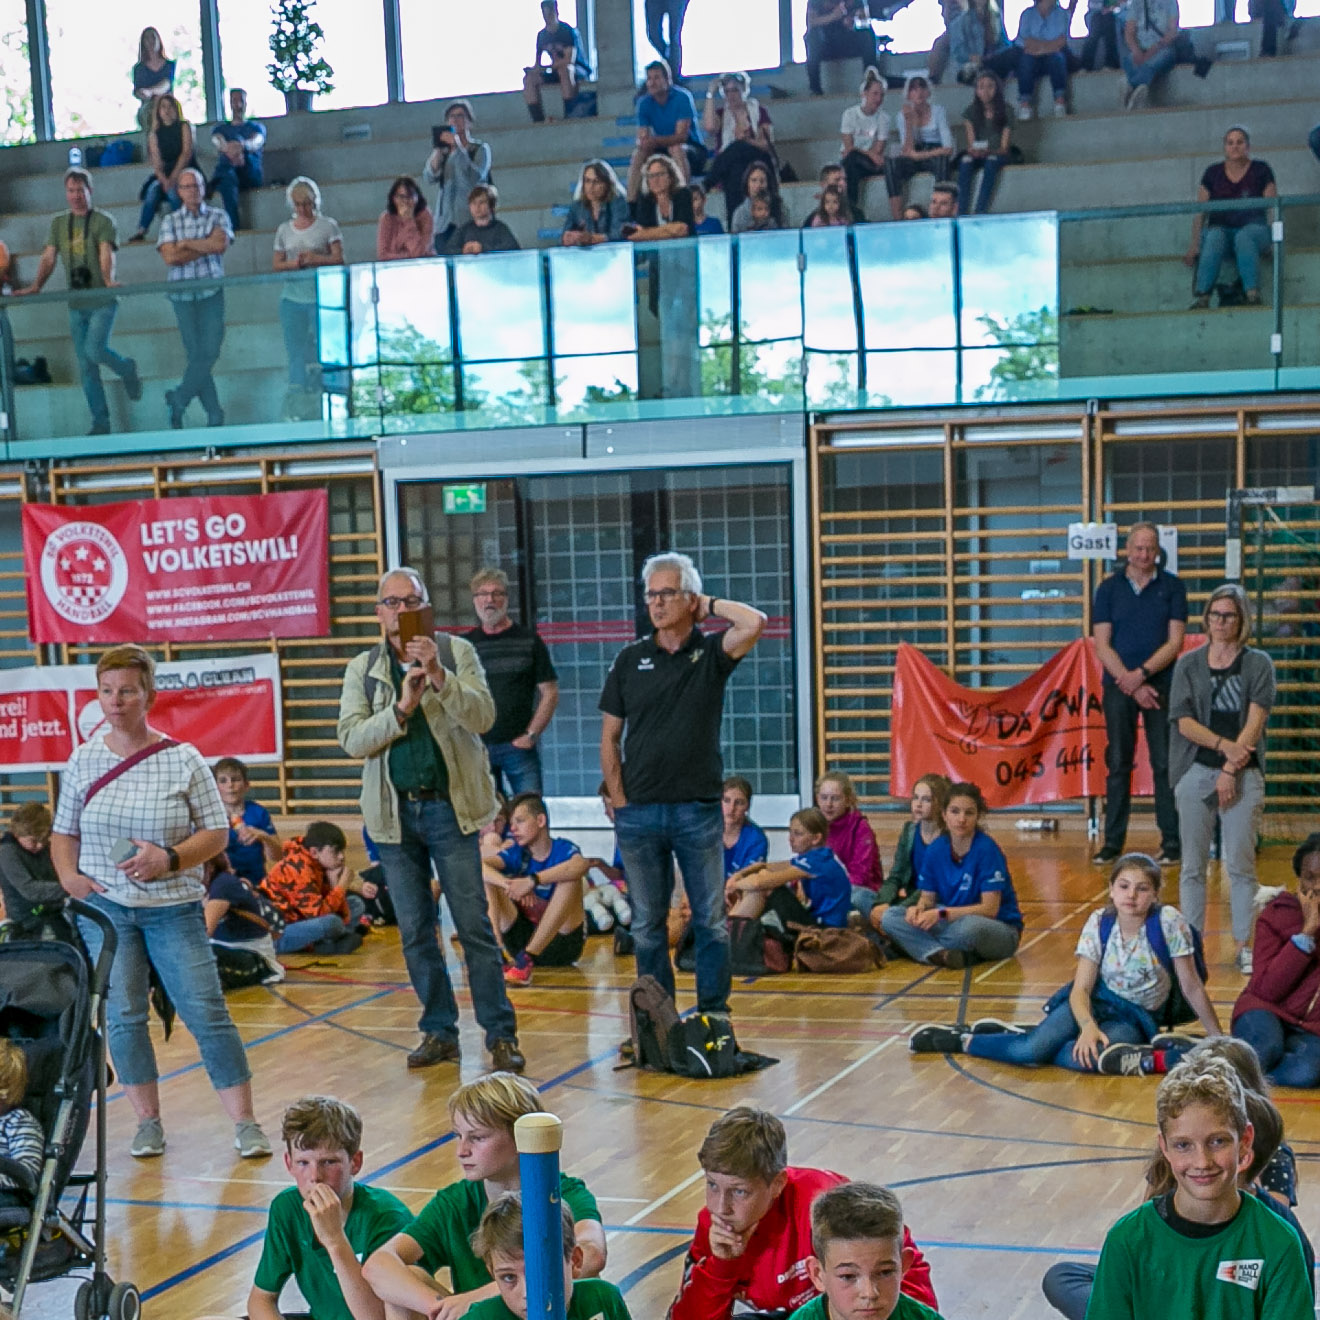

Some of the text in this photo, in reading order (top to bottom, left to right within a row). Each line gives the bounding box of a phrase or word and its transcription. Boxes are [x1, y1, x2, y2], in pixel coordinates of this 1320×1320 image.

[140, 512, 247, 547] LET'S GO
[1070, 534, 1112, 551] Gast
[142, 534, 299, 575] VOLKETSWIL!
[154, 673, 185, 691] OOL
[21, 717, 67, 742] jetzt.
[996, 750, 1046, 786] 043
